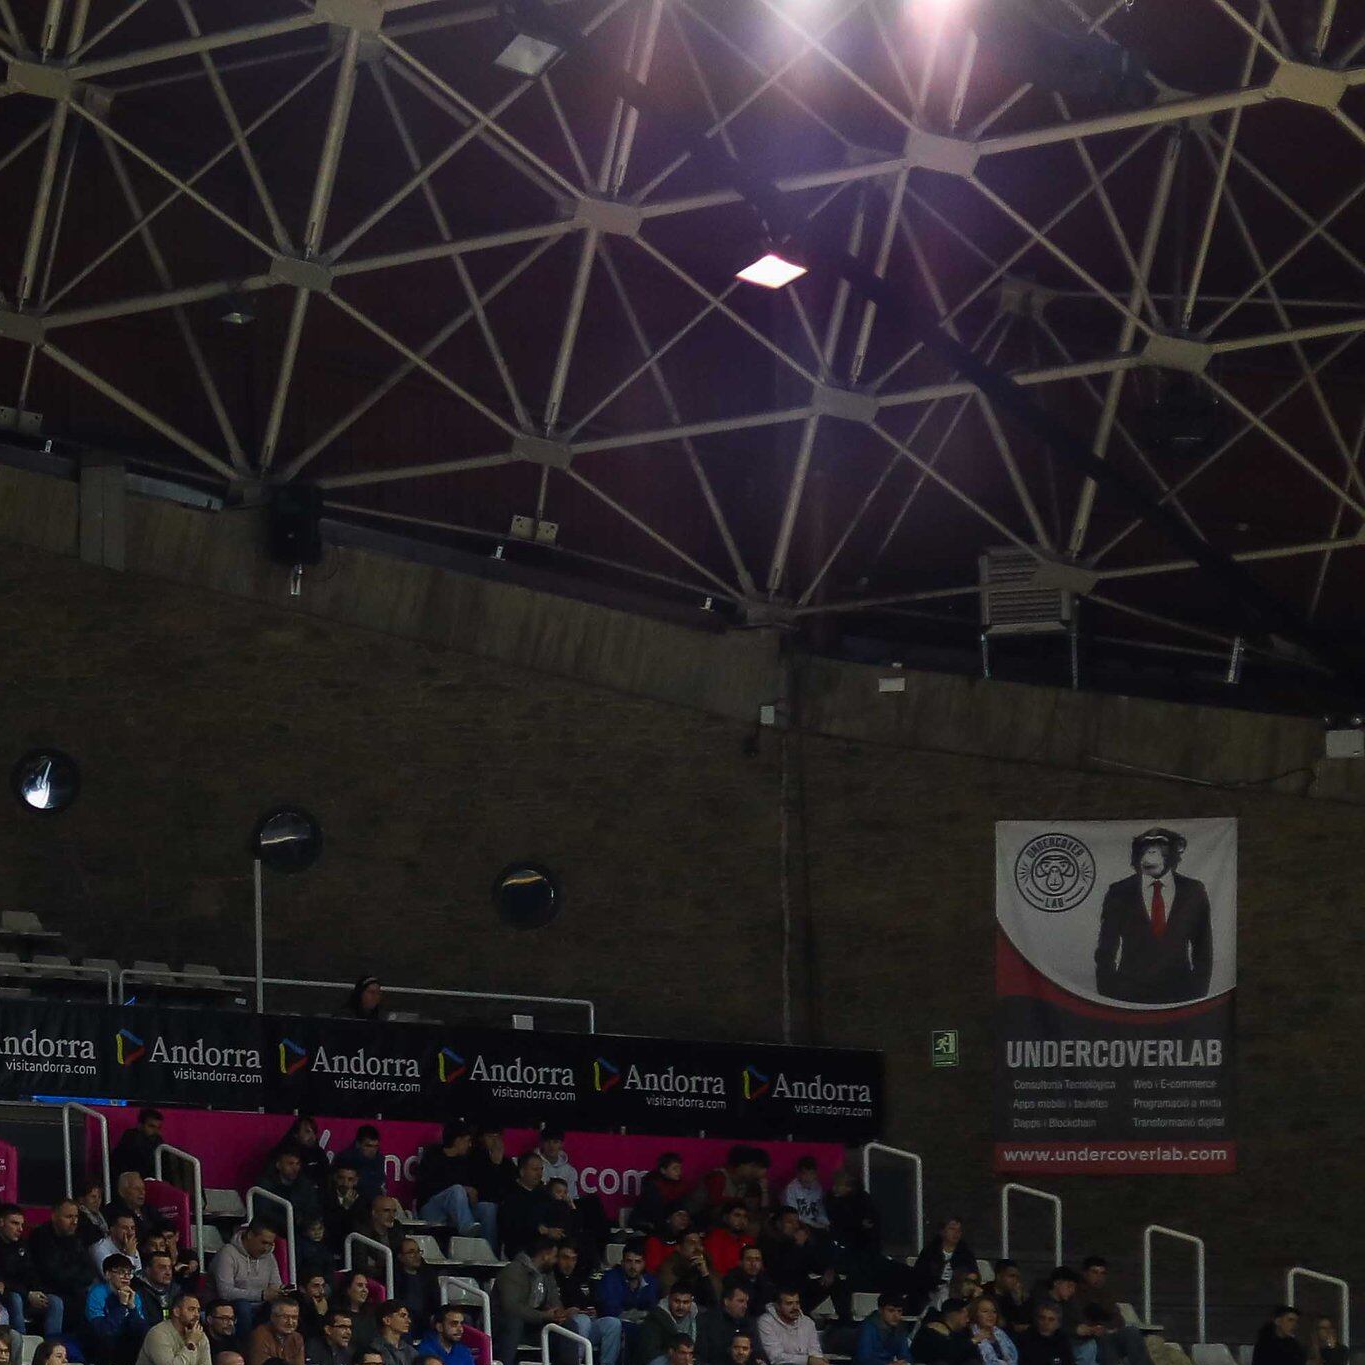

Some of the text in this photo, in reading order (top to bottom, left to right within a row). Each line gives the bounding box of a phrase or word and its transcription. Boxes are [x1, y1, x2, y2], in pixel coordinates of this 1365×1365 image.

[149, 1036, 262, 1069] Andorra
[311, 1045, 421, 1078] Andorra
[1006, 1039, 1223, 1068] UNDERCOVERLAB
[6, 1059, 97, 1076] visitandorra.com
[173, 1067, 263, 1085] visitandorra.com
[470, 1054, 576, 1087] Andorra
[334, 1076, 421, 1094] visitandorra.com
[623, 1063, 727, 1095] Andorra
[772, 1072, 872, 1103] Andorra
[492, 1085, 576, 1101] visitandorra.com
[645, 1093, 727, 1110] visitandorra.com
[794, 1101, 873, 1118] visitandorra.com
[1004, 1147, 1227, 1162] www.undercoverlab.com
